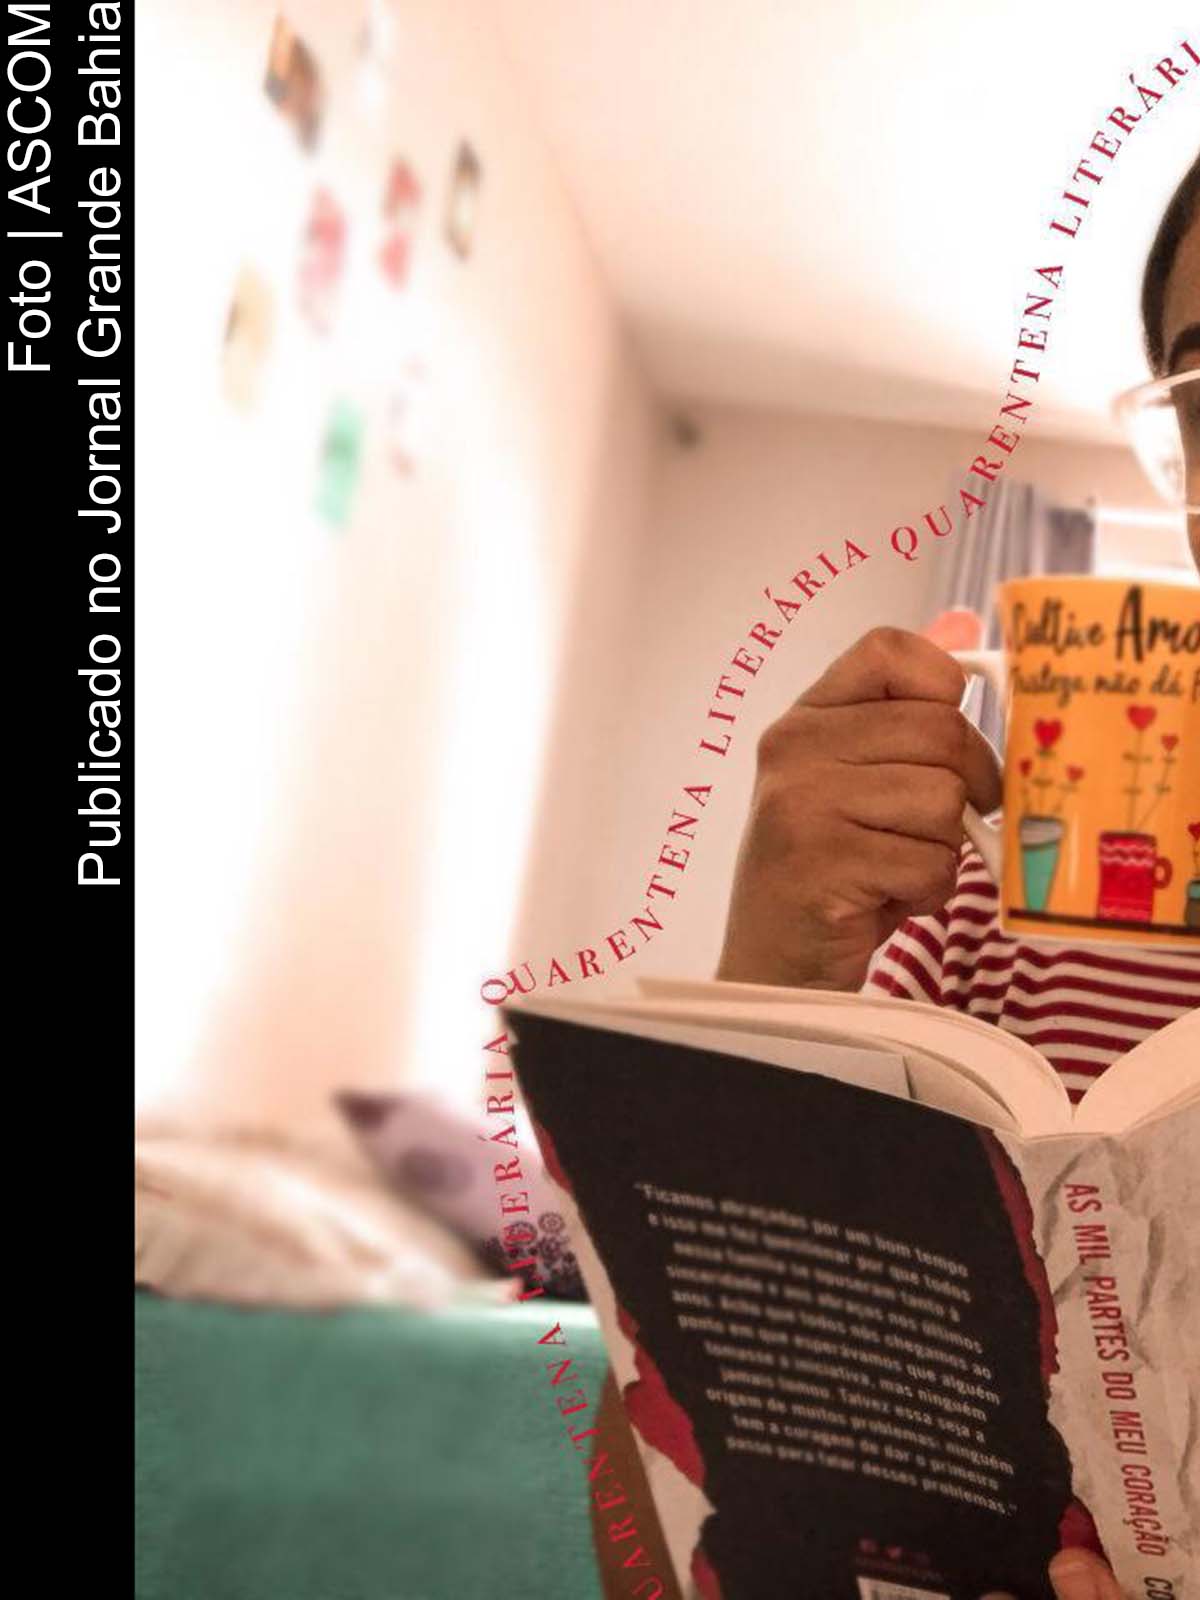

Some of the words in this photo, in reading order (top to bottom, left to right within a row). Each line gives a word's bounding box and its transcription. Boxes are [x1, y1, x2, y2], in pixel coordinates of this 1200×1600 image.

[1094, 668, 1141, 695] não
[1064, 1183, 1102, 1213] AS
[915, 1247, 969, 1278] tempo
[1071, 1224, 1111, 1265] MIL
[889, 1265, 920, 1285] que
[922, 1273, 970, 1303] todos
[1086, 1276, 1130, 1362] PARTES
[884, 1334, 968, 1371] chegamos
[971, 1362, 992, 1381] ao
[880, 1378, 913, 1399] mas
[917, 1388, 987, 1422] ninguém
[906, 1363, 936, 1382] que
[941, 1374, 1000, 1406] alguém
[1101, 1370, 1136, 1401] DO
[894, 1404, 932, 1425] essa
[936, 1416, 971, 1439] seja
[1110, 1409, 1147, 1455] MEU
[945, 1441, 1014, 1476] ninguém
[1120, 1464, 1172, 1558] CORAÇÃO
